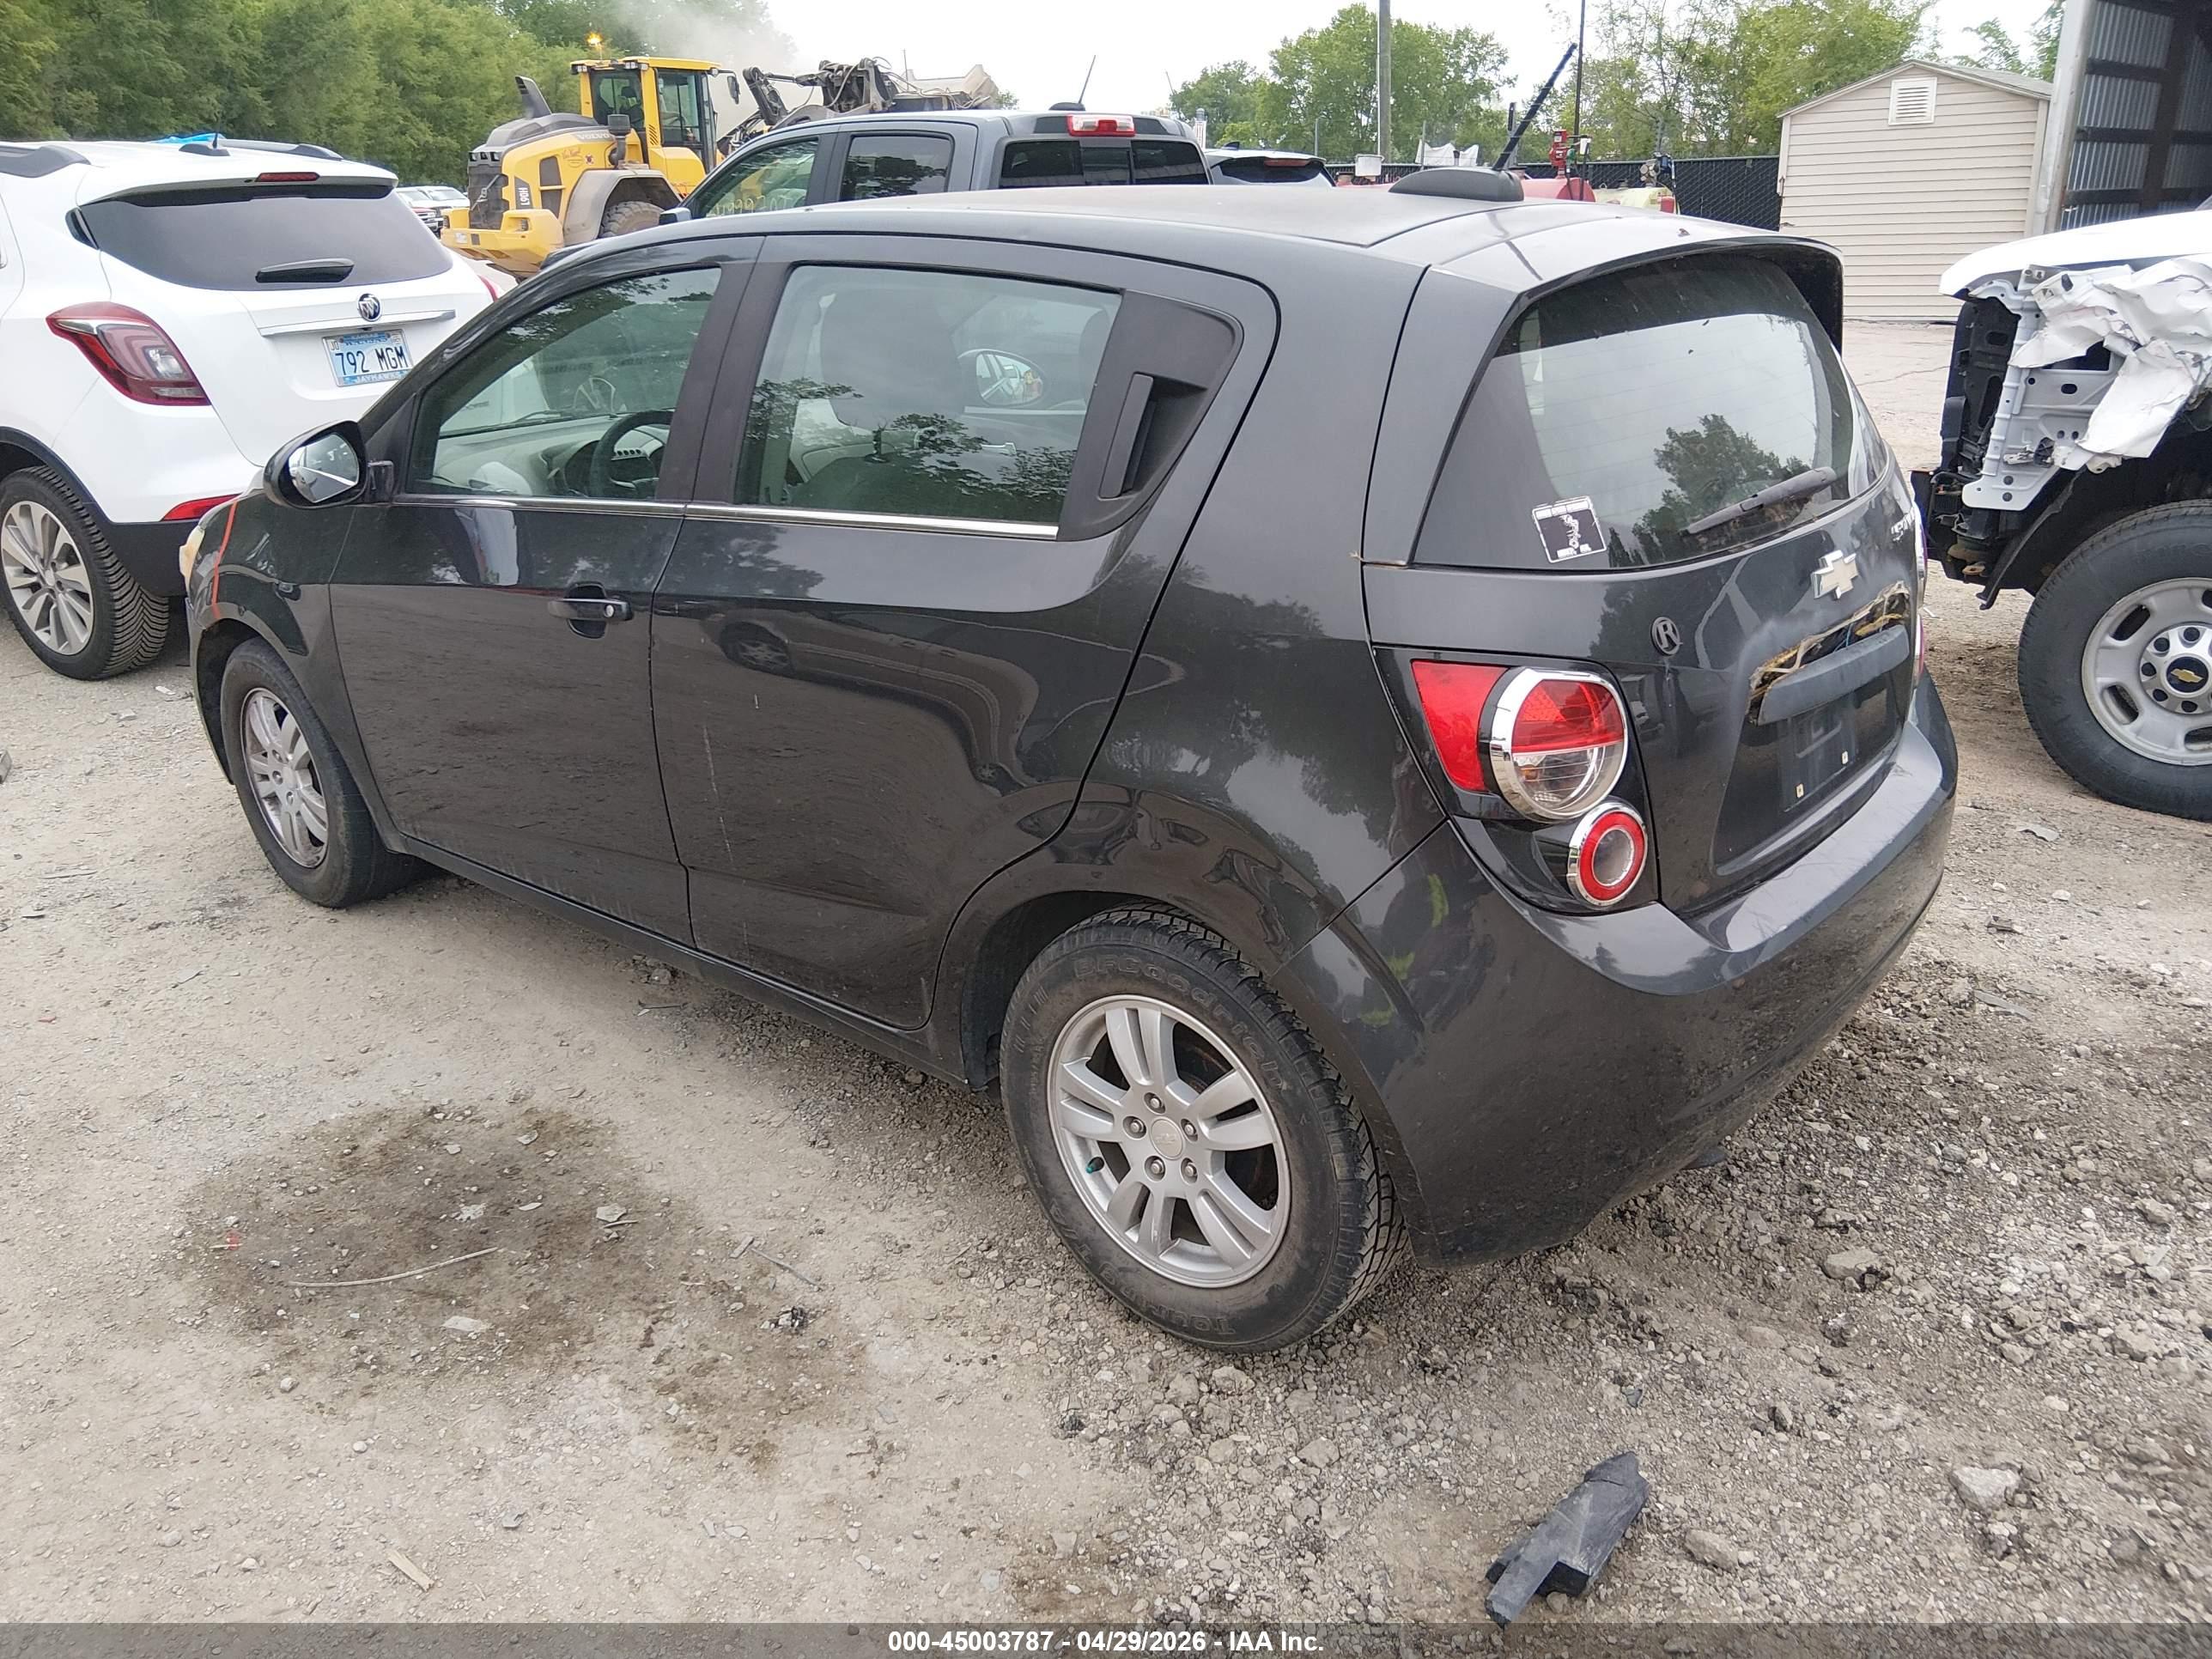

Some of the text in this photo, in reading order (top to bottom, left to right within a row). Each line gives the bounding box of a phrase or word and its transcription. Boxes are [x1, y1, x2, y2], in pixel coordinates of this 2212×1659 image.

[519, 187, 531, 206] L90H
[334, 346, 409, 375] 792 MGM
